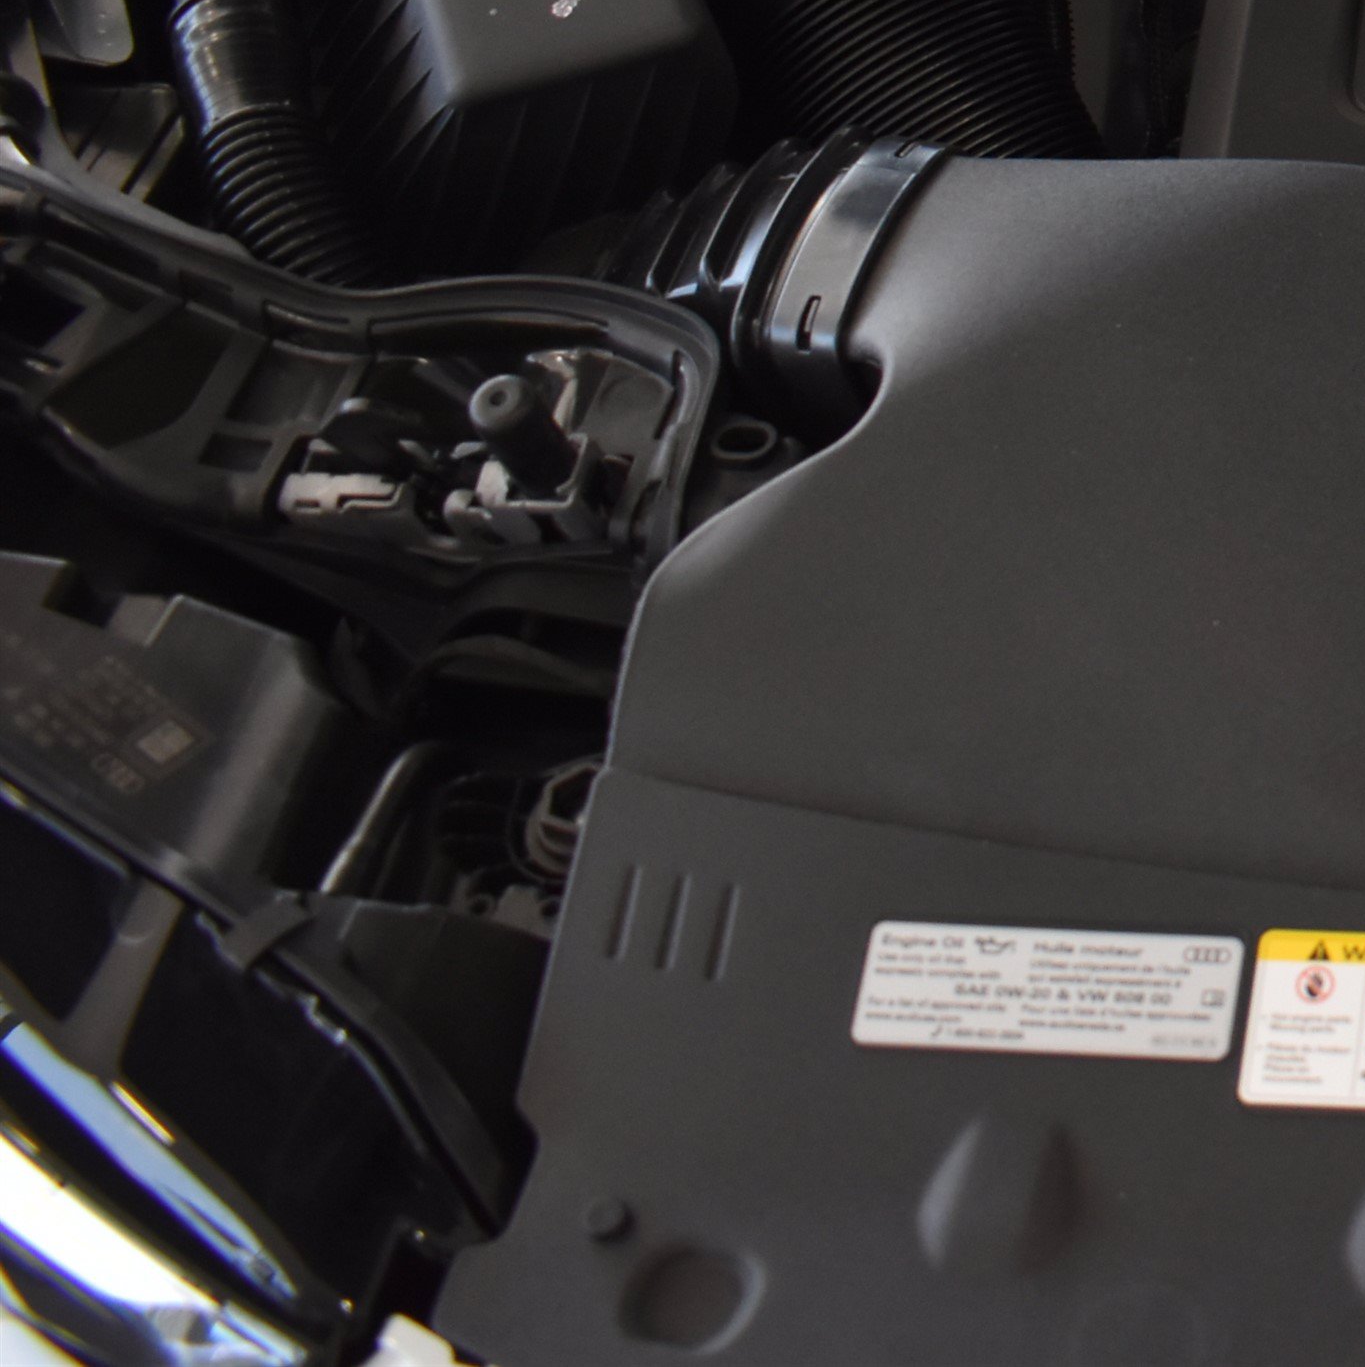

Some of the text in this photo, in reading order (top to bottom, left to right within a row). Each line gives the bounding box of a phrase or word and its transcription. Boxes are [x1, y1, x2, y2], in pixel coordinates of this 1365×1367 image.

[882, 933, 964, 950] Engine Oil
[954, 984, 988, 996] SAE
[1077, 988, 1108, 1002] VW
